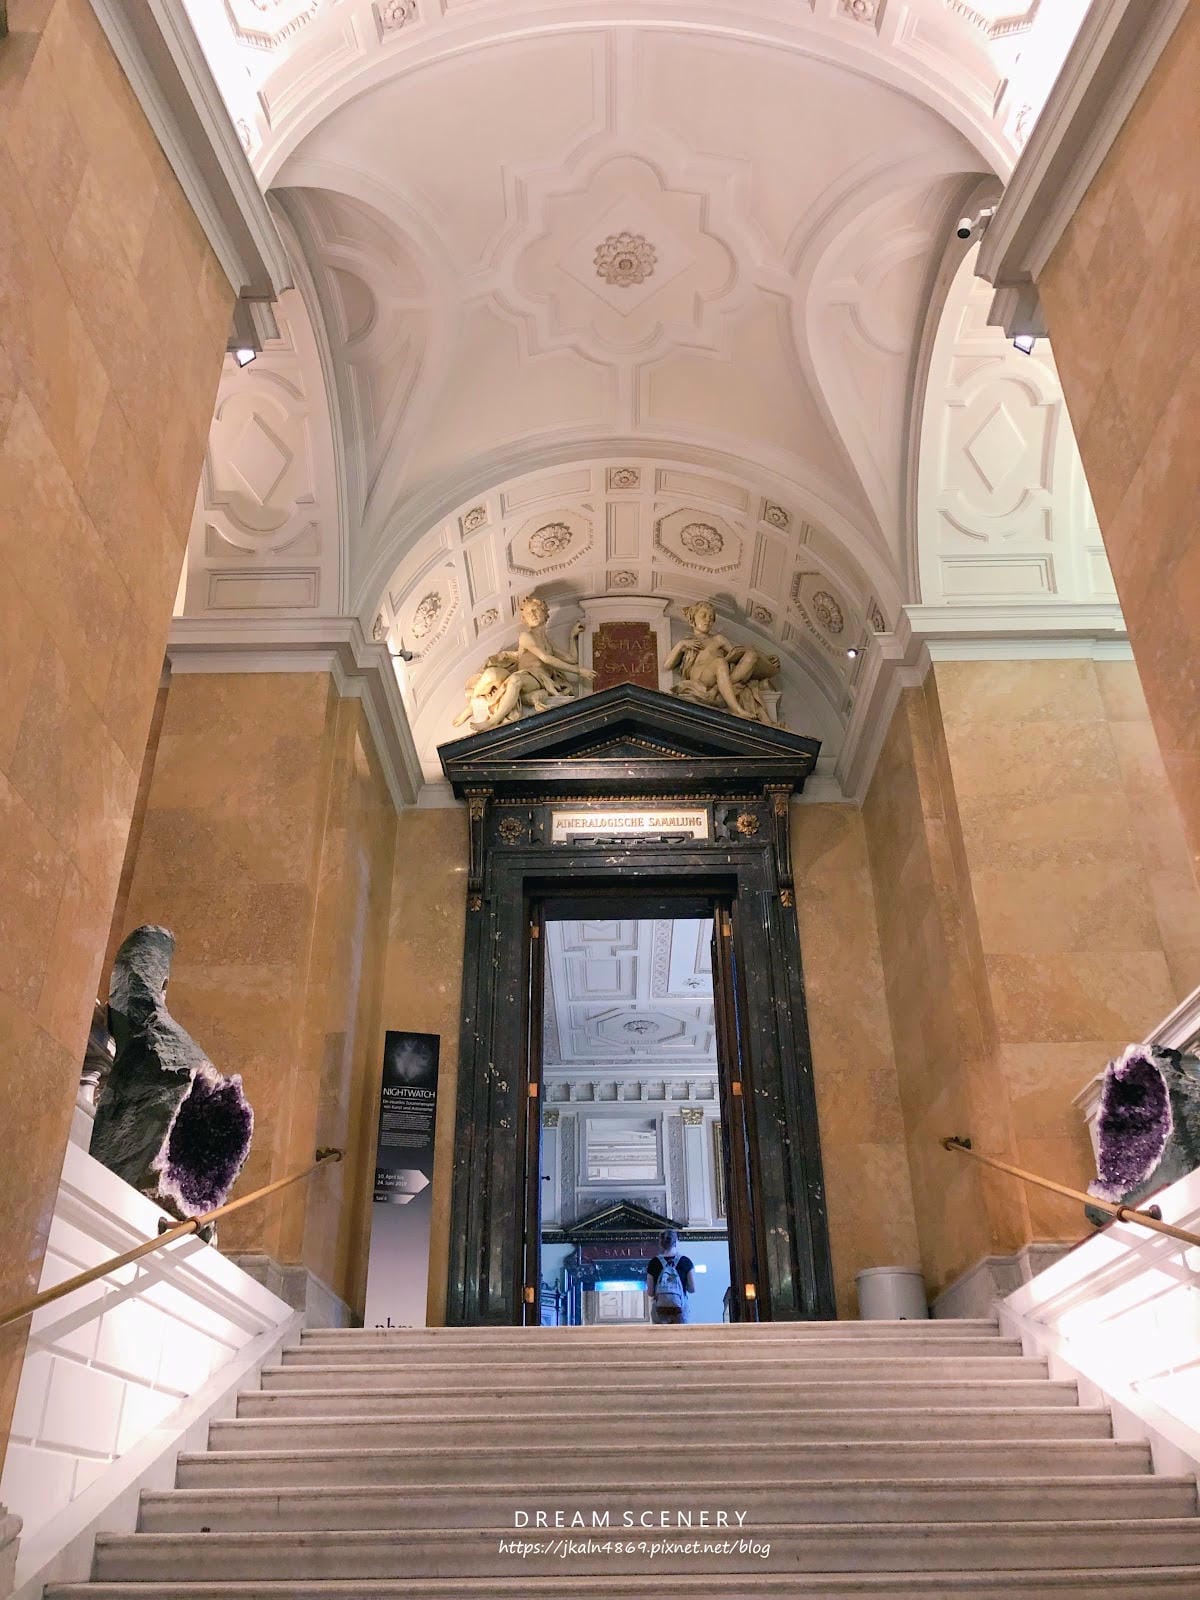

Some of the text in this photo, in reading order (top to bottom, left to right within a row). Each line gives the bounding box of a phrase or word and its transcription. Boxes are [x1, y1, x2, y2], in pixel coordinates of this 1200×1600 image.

[556, 817, 702, 828] MINERALOGISCHE SAMMLUNG
[383, 1088, 436, 1098] NIGHTWATCH
